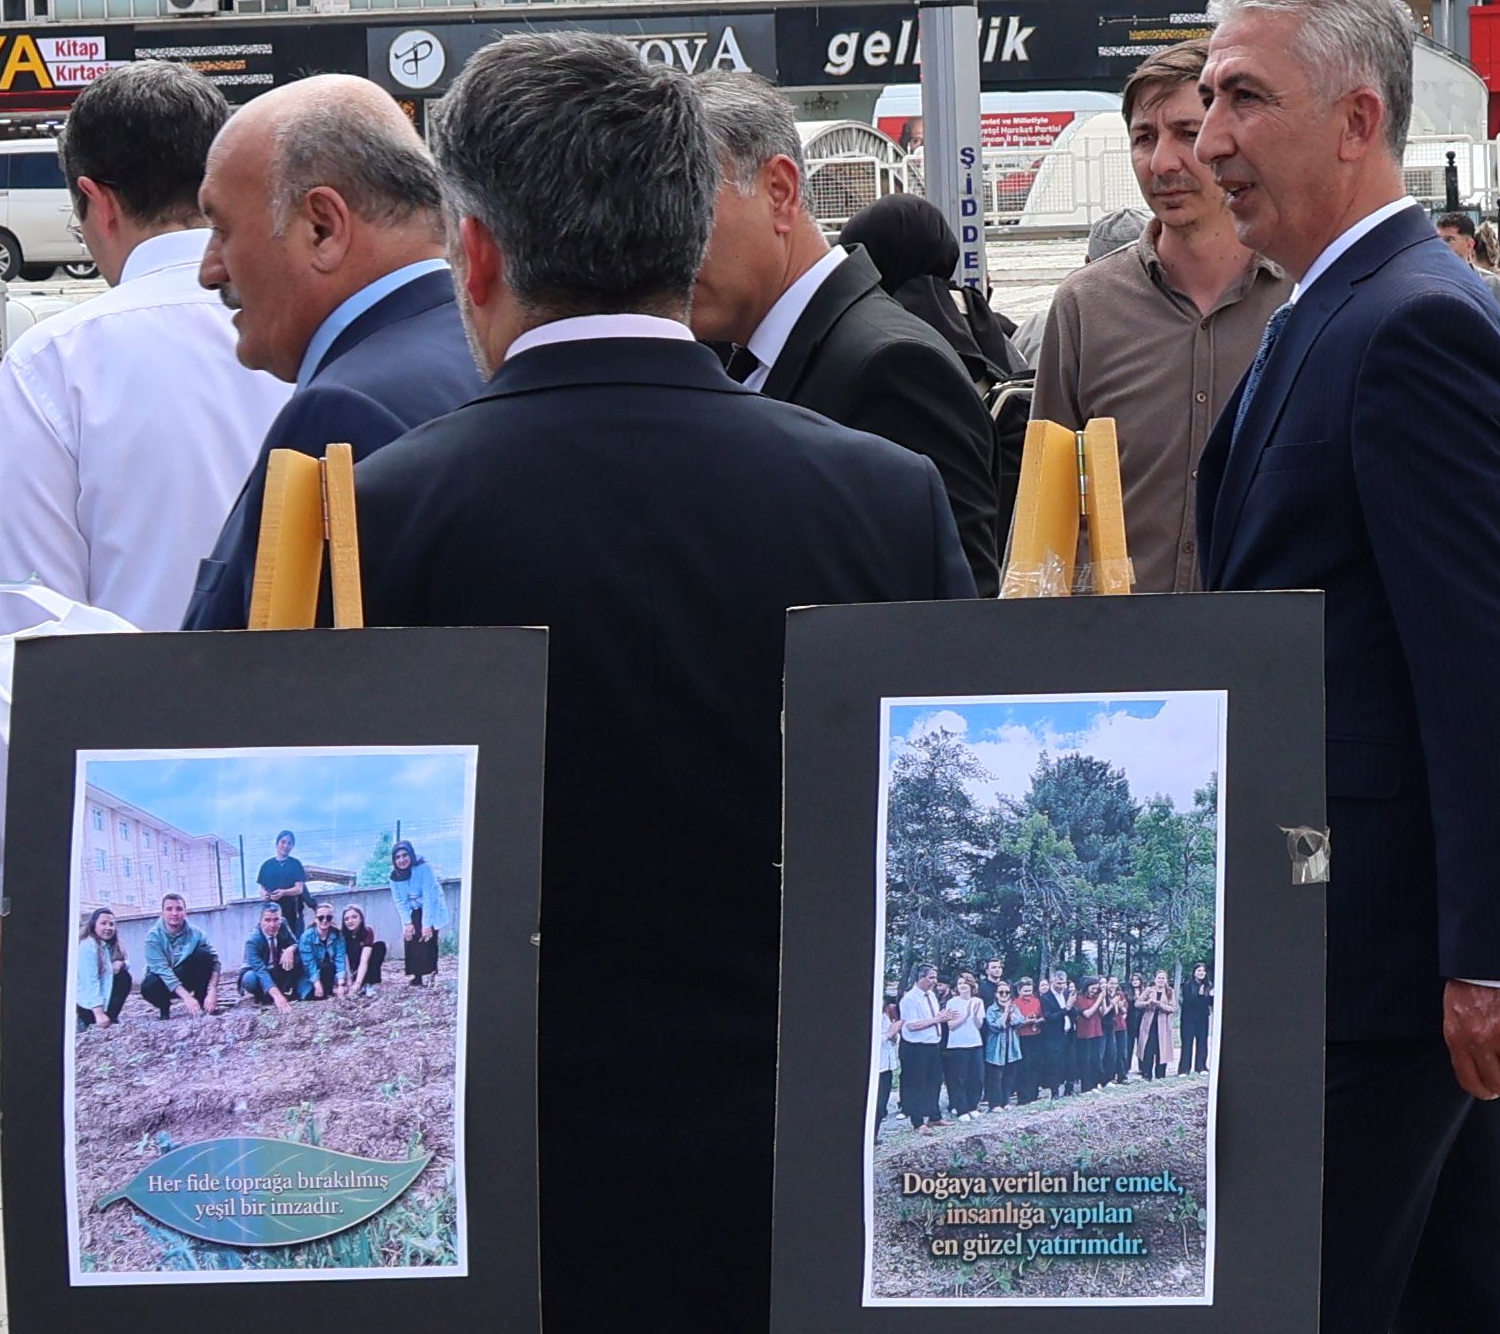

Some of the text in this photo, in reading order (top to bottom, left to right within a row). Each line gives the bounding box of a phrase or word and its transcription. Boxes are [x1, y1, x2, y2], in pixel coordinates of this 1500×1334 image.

[55, 38, 99, 59] Kitap
[148, 1171, 389, 1195] Her fide toprağa bırakılmış
[903, 1170, 1184, 1199] Doğaya verilen her emek,
[195, 1196, 344, 1220] yeşil bir imzadır.
[946, 1202, 1132, 1230] insanlığa yapılan
[932, 1232, 1147, 1260] en güzel yatırımdır.
